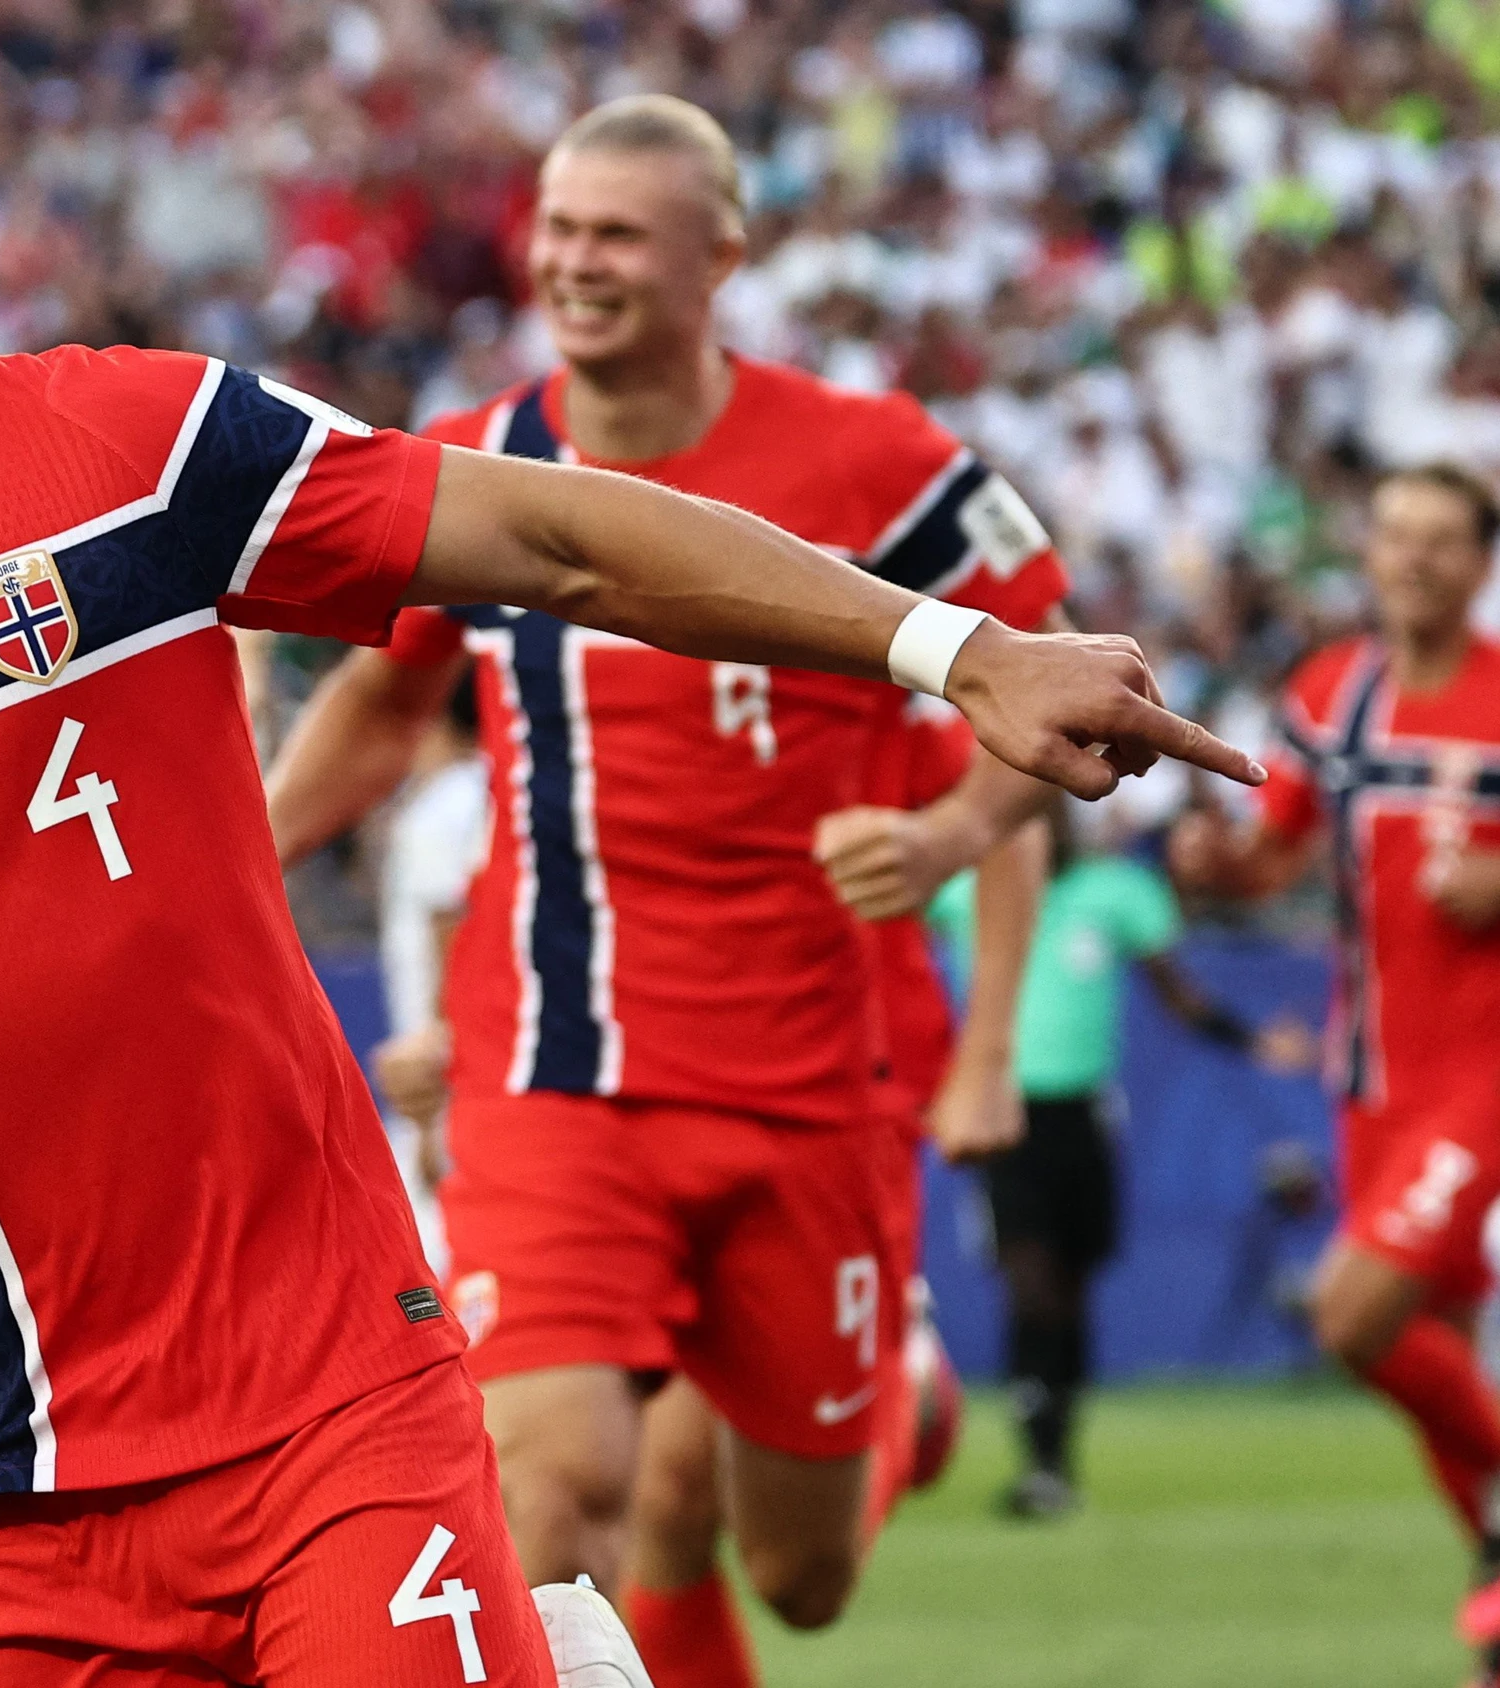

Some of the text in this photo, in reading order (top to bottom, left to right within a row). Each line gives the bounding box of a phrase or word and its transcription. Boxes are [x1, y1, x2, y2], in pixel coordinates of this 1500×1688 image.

[711, 660, 777, 767] 9
[26, 716, 133, 882] 4
[836, 1256, 880, 1370] 9
[388, 1522, 488, 1684] 4
